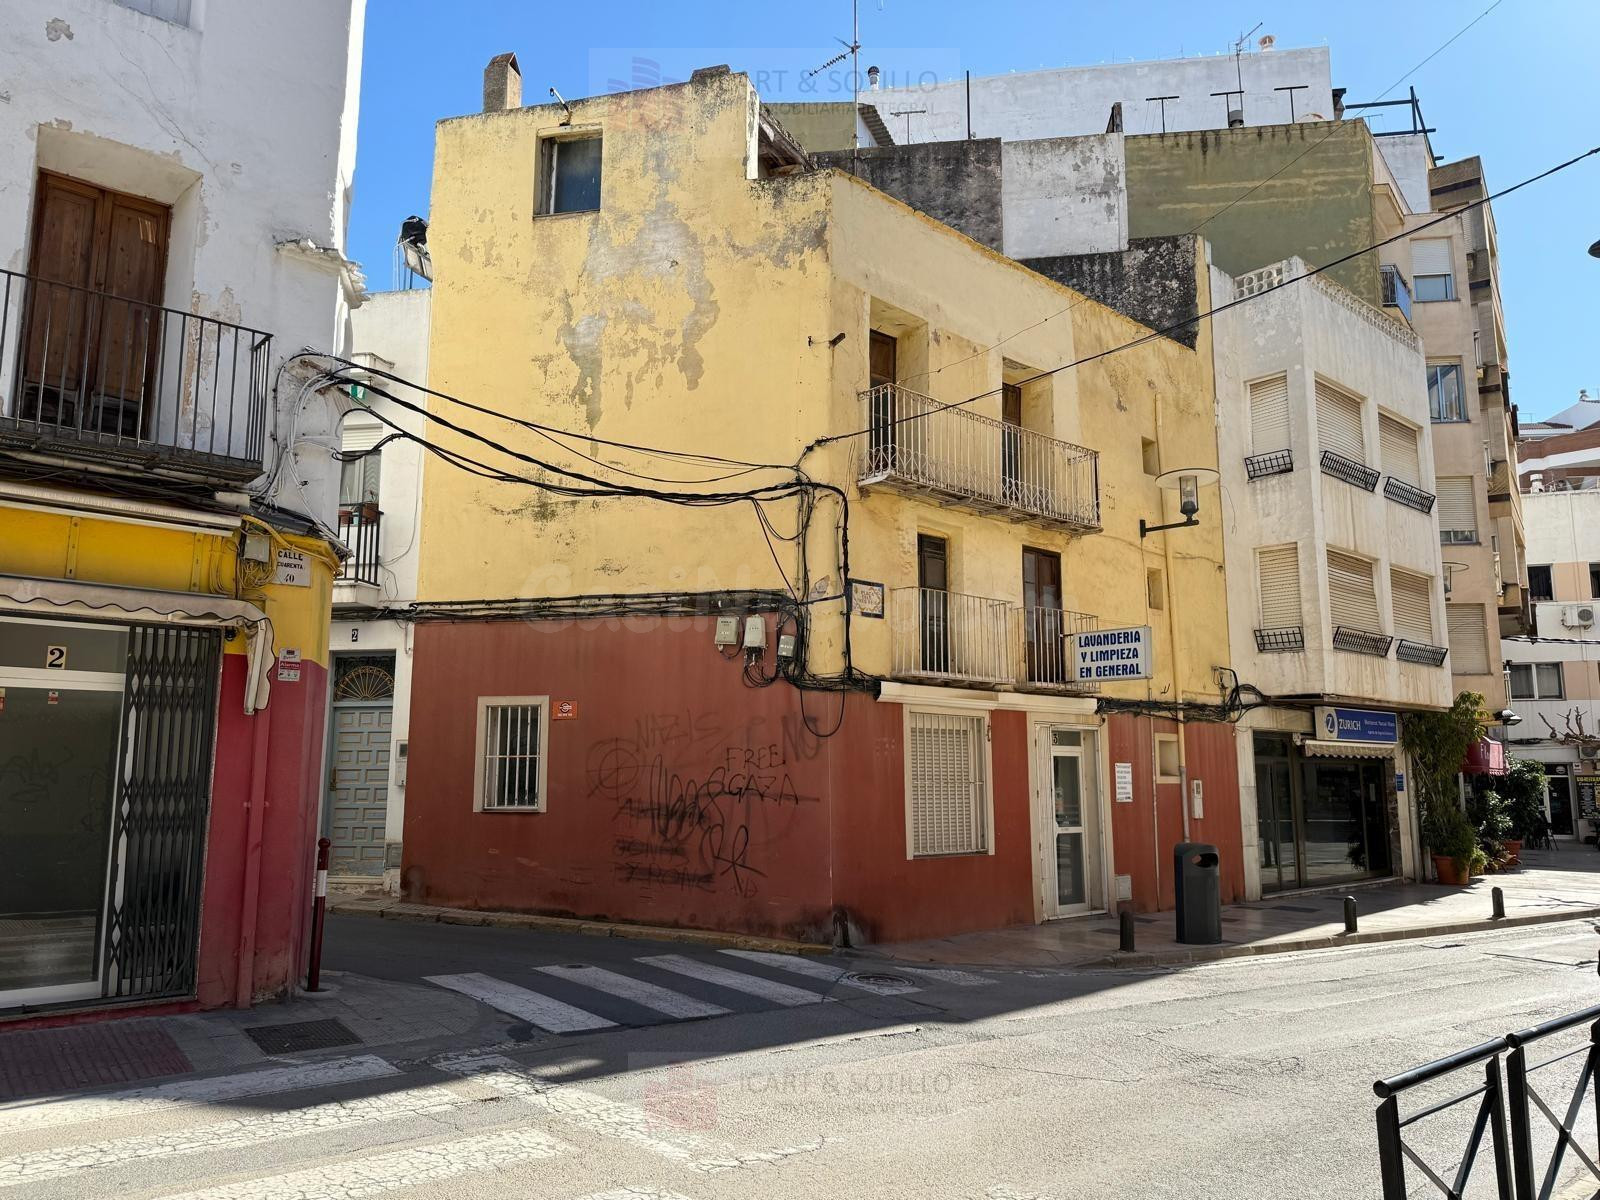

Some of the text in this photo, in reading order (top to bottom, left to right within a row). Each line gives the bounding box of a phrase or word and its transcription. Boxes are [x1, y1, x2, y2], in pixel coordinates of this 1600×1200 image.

[278, 551, 304, 561] CALLE
[284, 574, 295, 583] 40
[352, 630, 358, 640] 2
[1079, 630, 1141, 648] LAVANDERIA
[48, 647, 65, 667] 2
[1081, 648, 1139, 663] Y LIMPIEZA
[1080, 663, 1141, 678] EN GENERAL
[1338, 719, 1361, 731] ZURICH
[726, 744, 785, 771] FREE
[728, 773, 799, 806] GAZA
